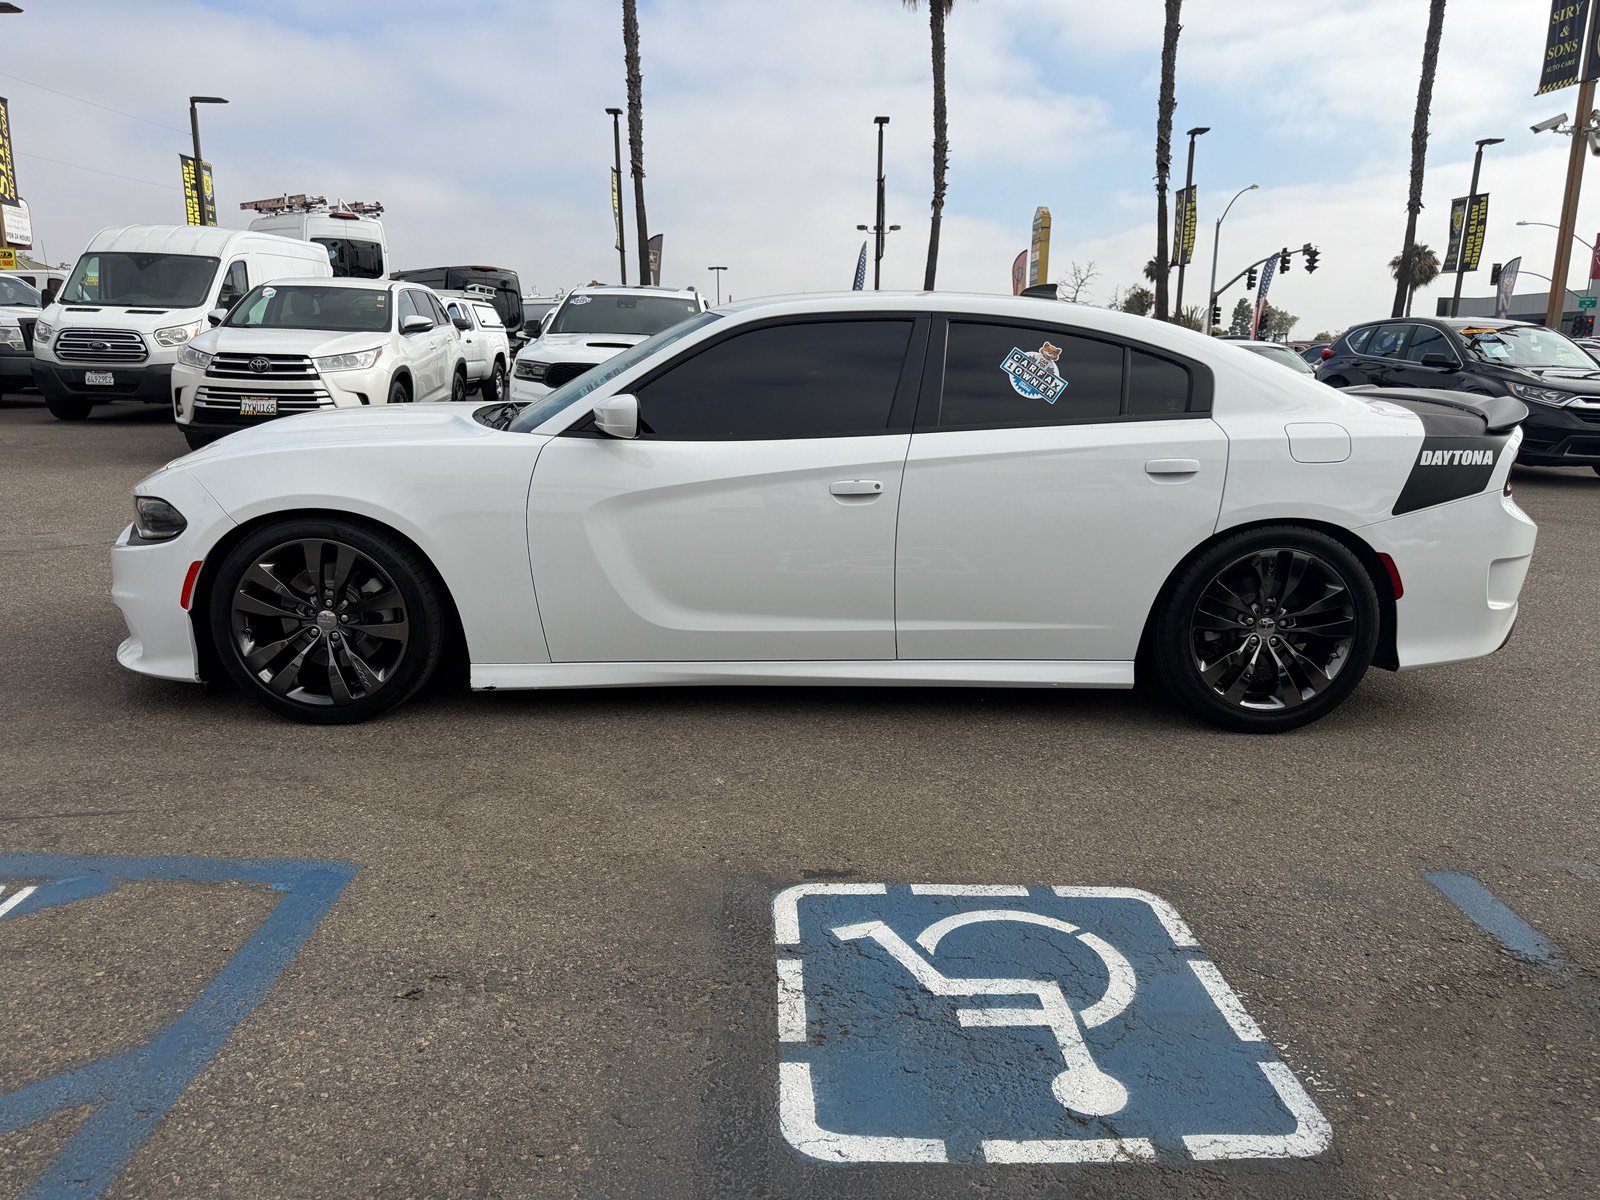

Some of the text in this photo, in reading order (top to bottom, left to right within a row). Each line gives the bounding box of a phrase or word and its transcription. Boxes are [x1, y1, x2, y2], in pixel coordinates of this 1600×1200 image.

[1552, 1, 1584, 25] SIRY
[1559, 26, 1570, 38] &
[1546, 38, 1579, 60] SONS
[183, 165, 192, 197] AUTO
[187, 159, 197, 185] FULL
[1464, 204, 1479, 263] AUTO CARE
[1469, 196, 1488, 269] FULL SERVICE
[1005, 362, 1013, 370] 1
[1014, 366, 1055, 399] OWNER
[1013, 353, 1060, 391] CARFAX
[1420, 450, 1493, 466] DAYTONA
